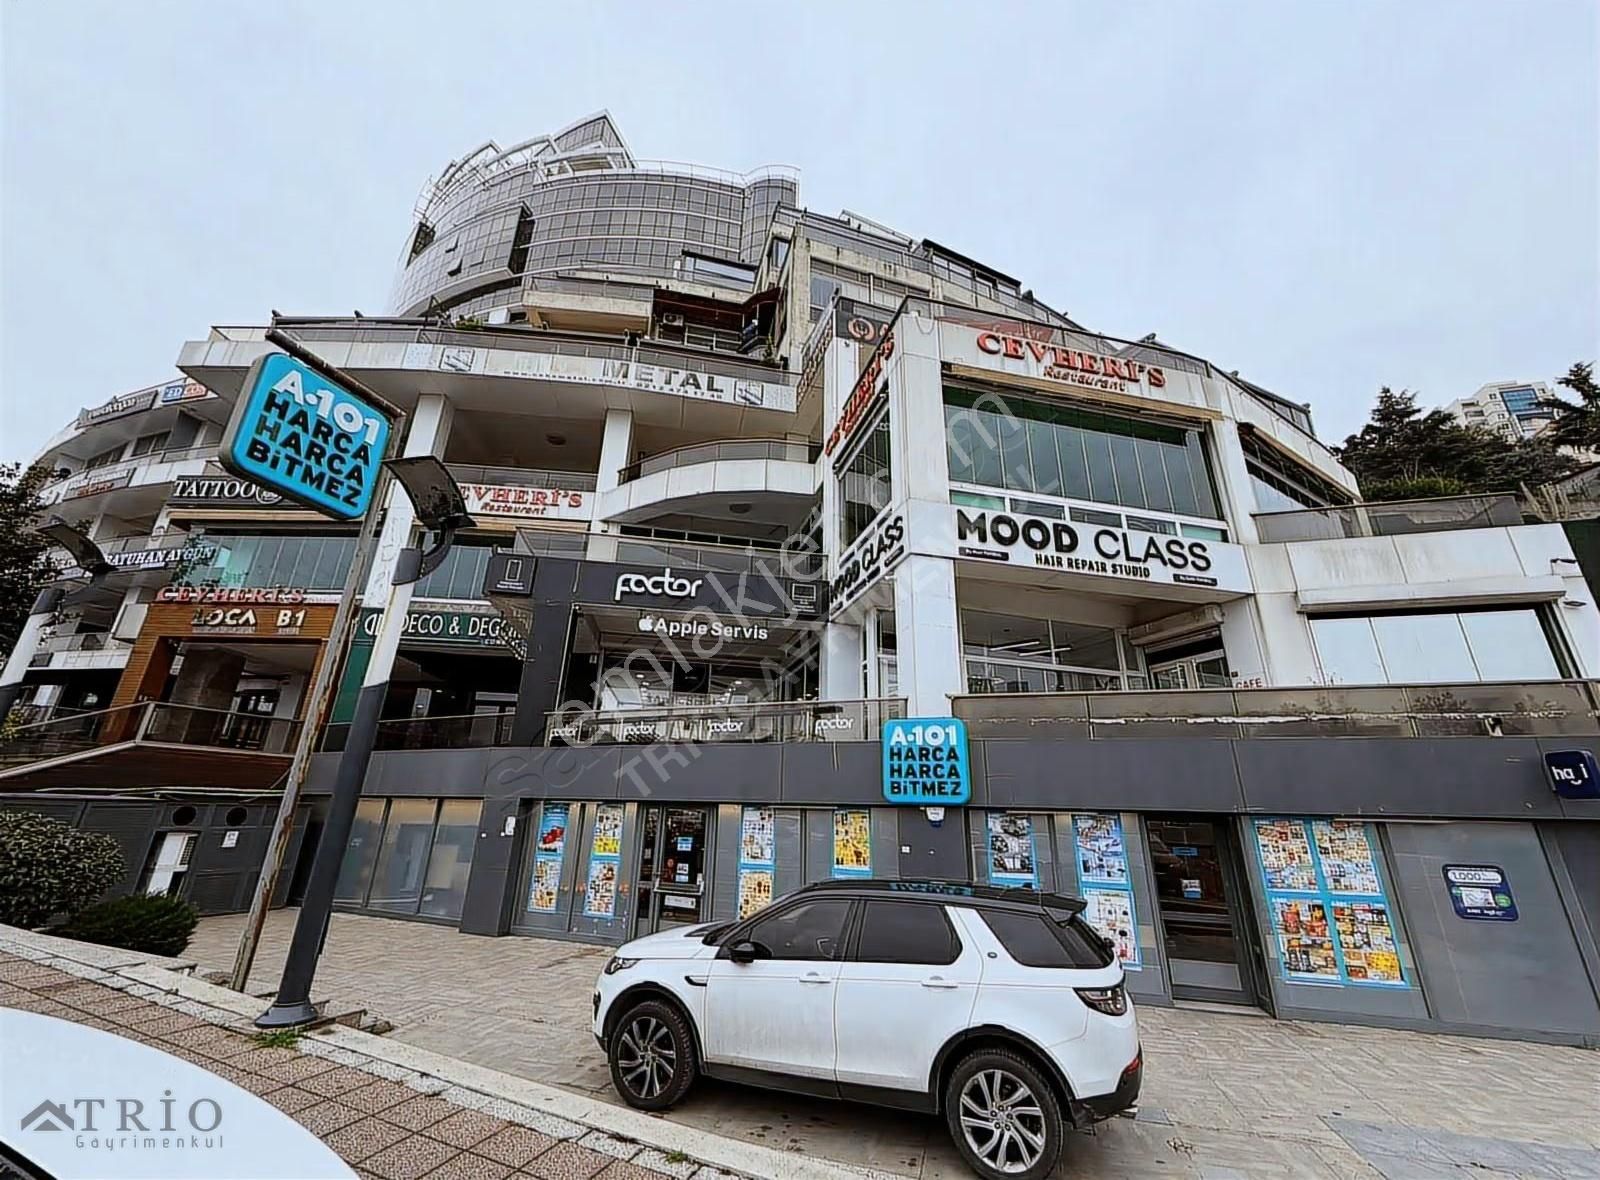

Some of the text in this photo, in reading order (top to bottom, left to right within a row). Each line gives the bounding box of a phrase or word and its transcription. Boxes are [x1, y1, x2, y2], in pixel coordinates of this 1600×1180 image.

[603, 359, 724, 393] METAL
[263, 391, 371, 467] HARCA
[255, 414, 365, 488] HARCA
[173, 480, 256, 498] TATTOO
[861, 516, 904, 572] CLASS
[957, 508, 1211, 572] MOOD CLASS
[1035, 553, 1151, 578] HAIR REPAIR STUDIO
[191, 608, 257, 626] LOCA
[449, 616, 460, 635] &
[653, 616, 768, 640] Apple Servis
[1236, 677, 1263, 688] CAFE
[889, 746, 960, 762] HARCA
[889, 763, 961, 779] HARCA
